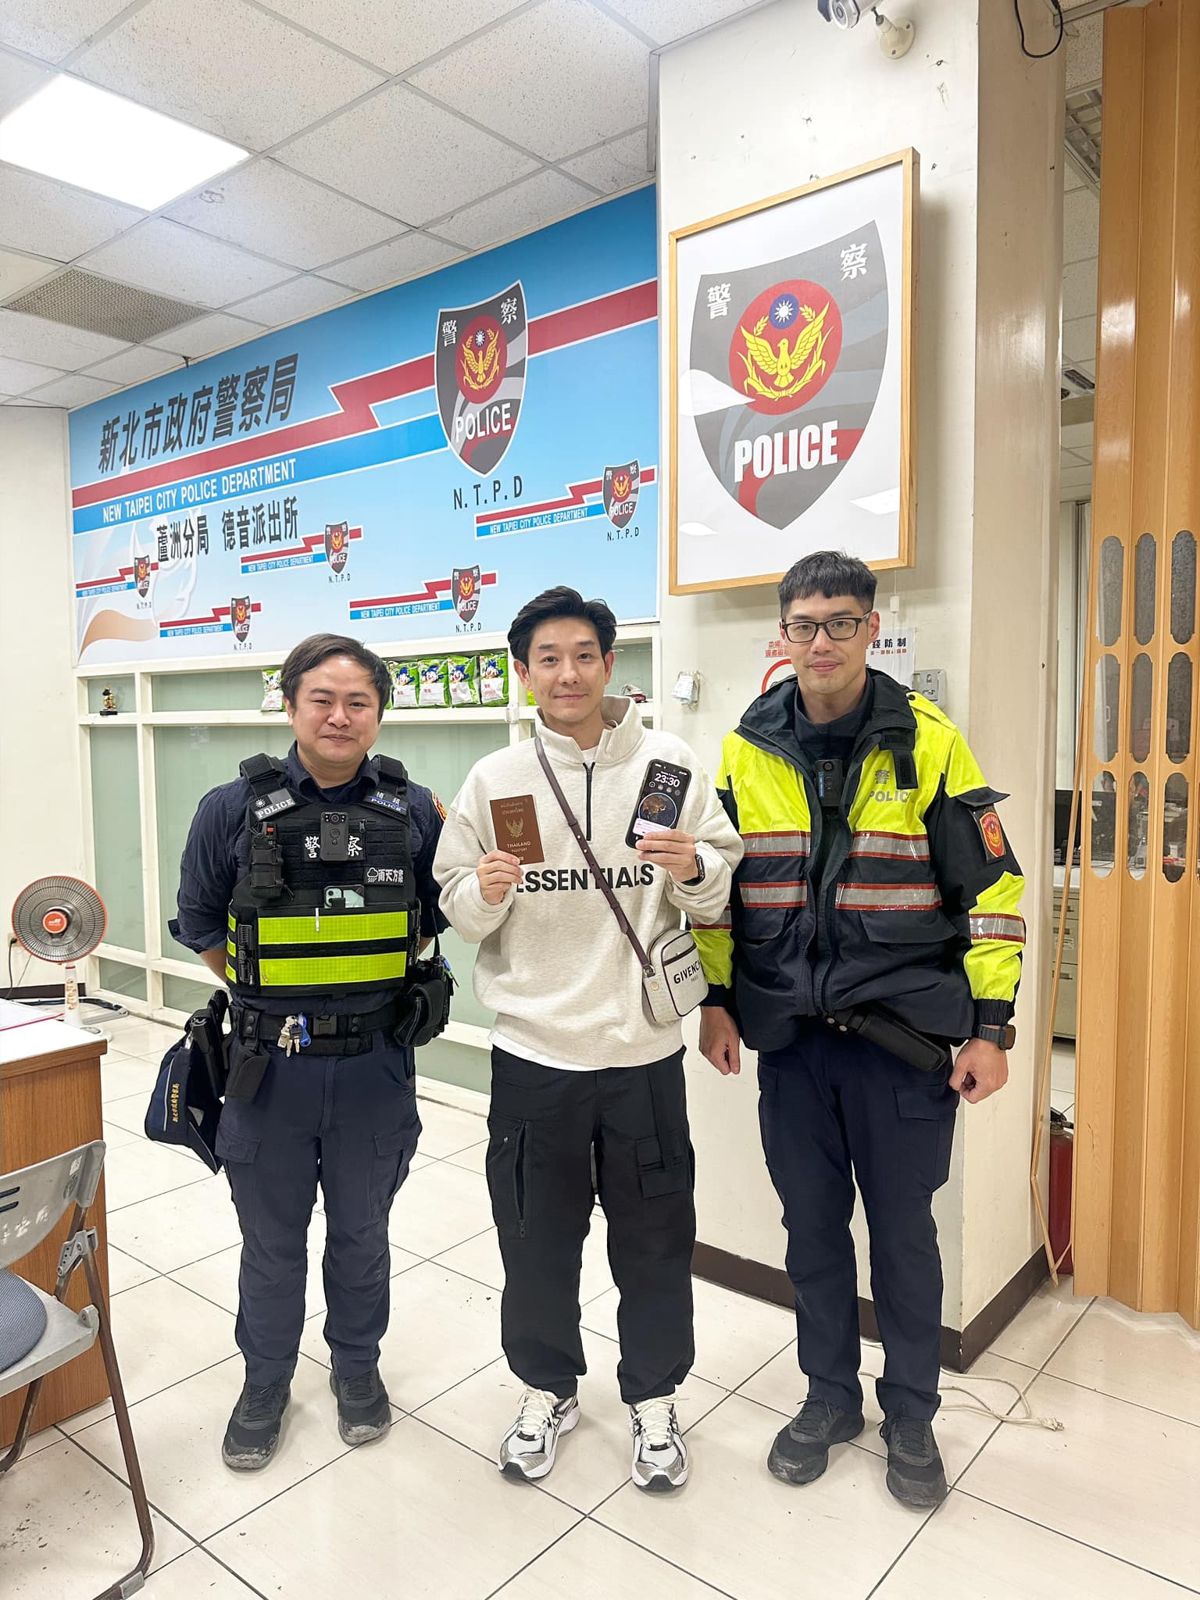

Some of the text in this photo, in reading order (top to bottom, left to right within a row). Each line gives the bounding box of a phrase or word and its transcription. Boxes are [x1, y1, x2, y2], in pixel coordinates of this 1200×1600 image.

[706, 243, 868, 319] 警 察
[442, 298, 517, 347] 警 察
[98, 353, 299, 474] 新北市政府警察局
[455, 402, 512, 443] POLICE
[734, 420, 839, 483] POLICE
[102, 458, 297, 523] NEW TAIPEI CITY POLICE DEPARTMENT
[609, 502, 634, 517] POLICE
[157, 496, 299, 562] 蘆洲分局 德音派出所
[489, 523, 501, 534] NEW
[520, 519, 532, 530] CITY
[533, 515, 552, 527] POLICE
[554, 508, 589, 523] DEPARTMENT
[457, 600, 477, 612] POLICE
[654, 772, 681, 788] 23:30
[256, 798, 296, 819] POLICE
[304, 835, 363, 859] 警 察
